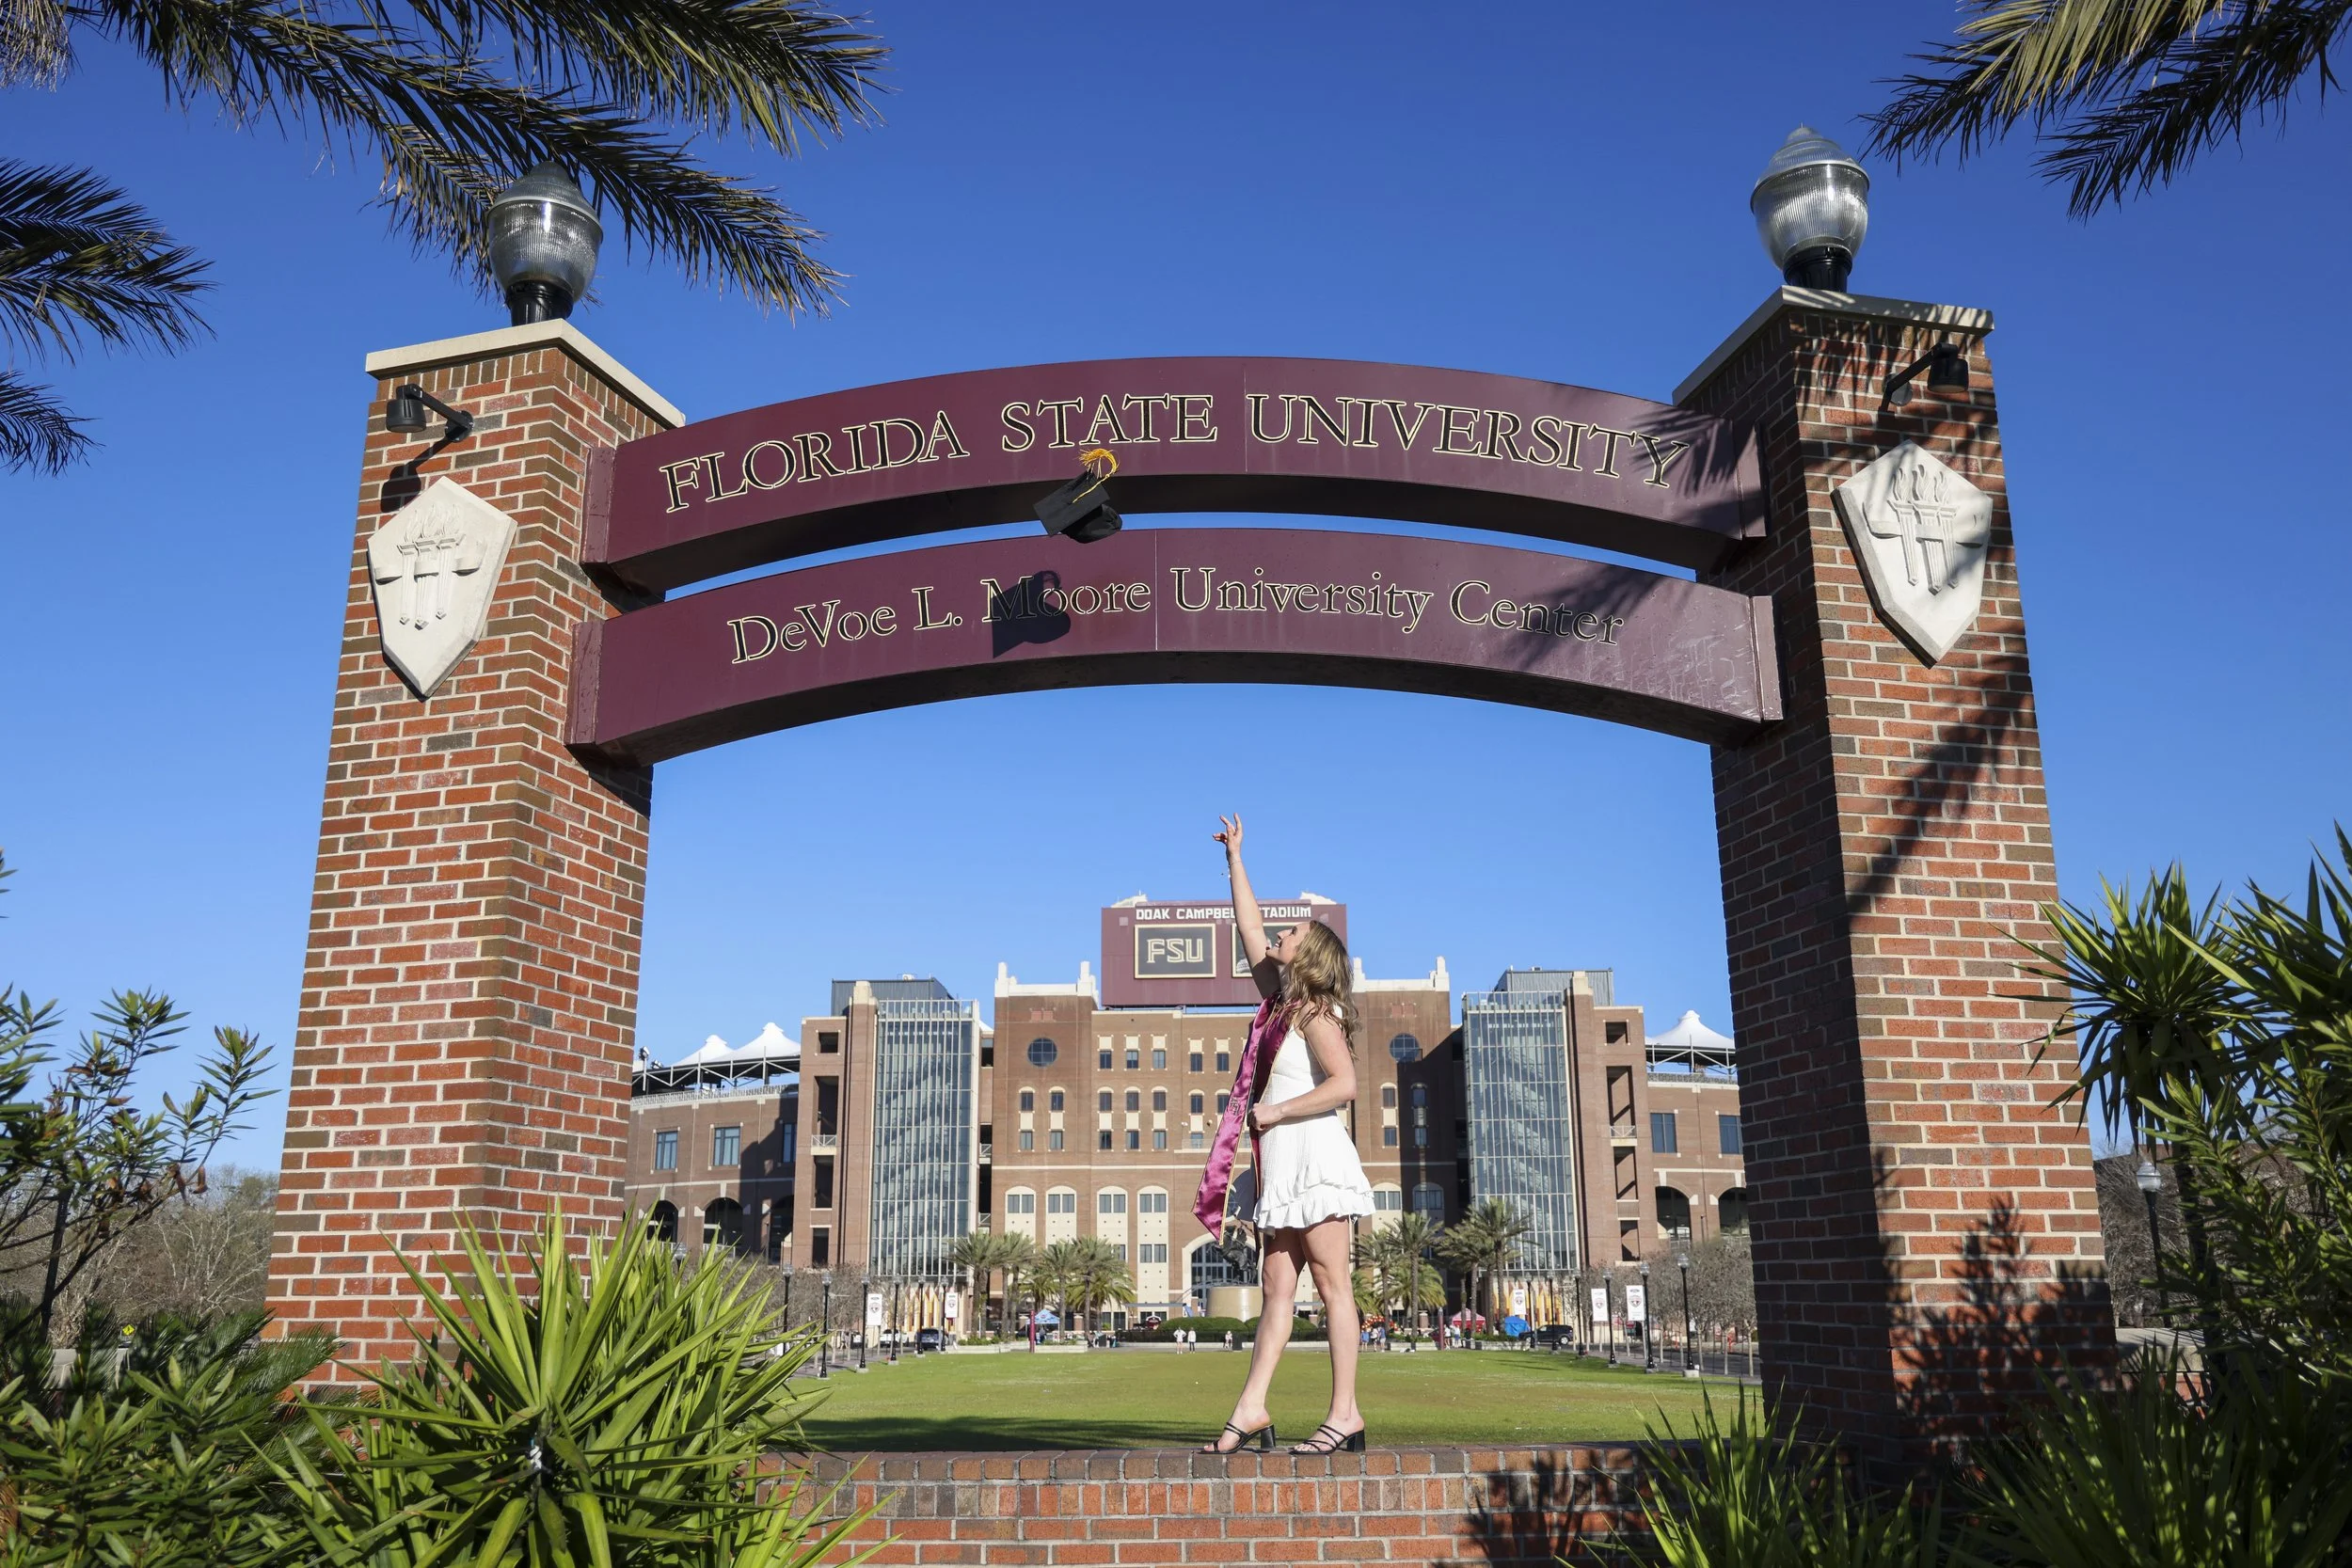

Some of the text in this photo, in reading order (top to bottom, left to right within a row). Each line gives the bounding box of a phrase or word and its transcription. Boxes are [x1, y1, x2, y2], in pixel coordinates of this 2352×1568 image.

[660, 393, 1689, 515] FLORIDA STATE UNIVERSITY
[726, 568, 1624, 664] DeVoe L. Moore University Center
[1136, 906, 1311, 920] DOAK CAMPBEL TADIUM
[1146, 938, 1203, 963] FSU
